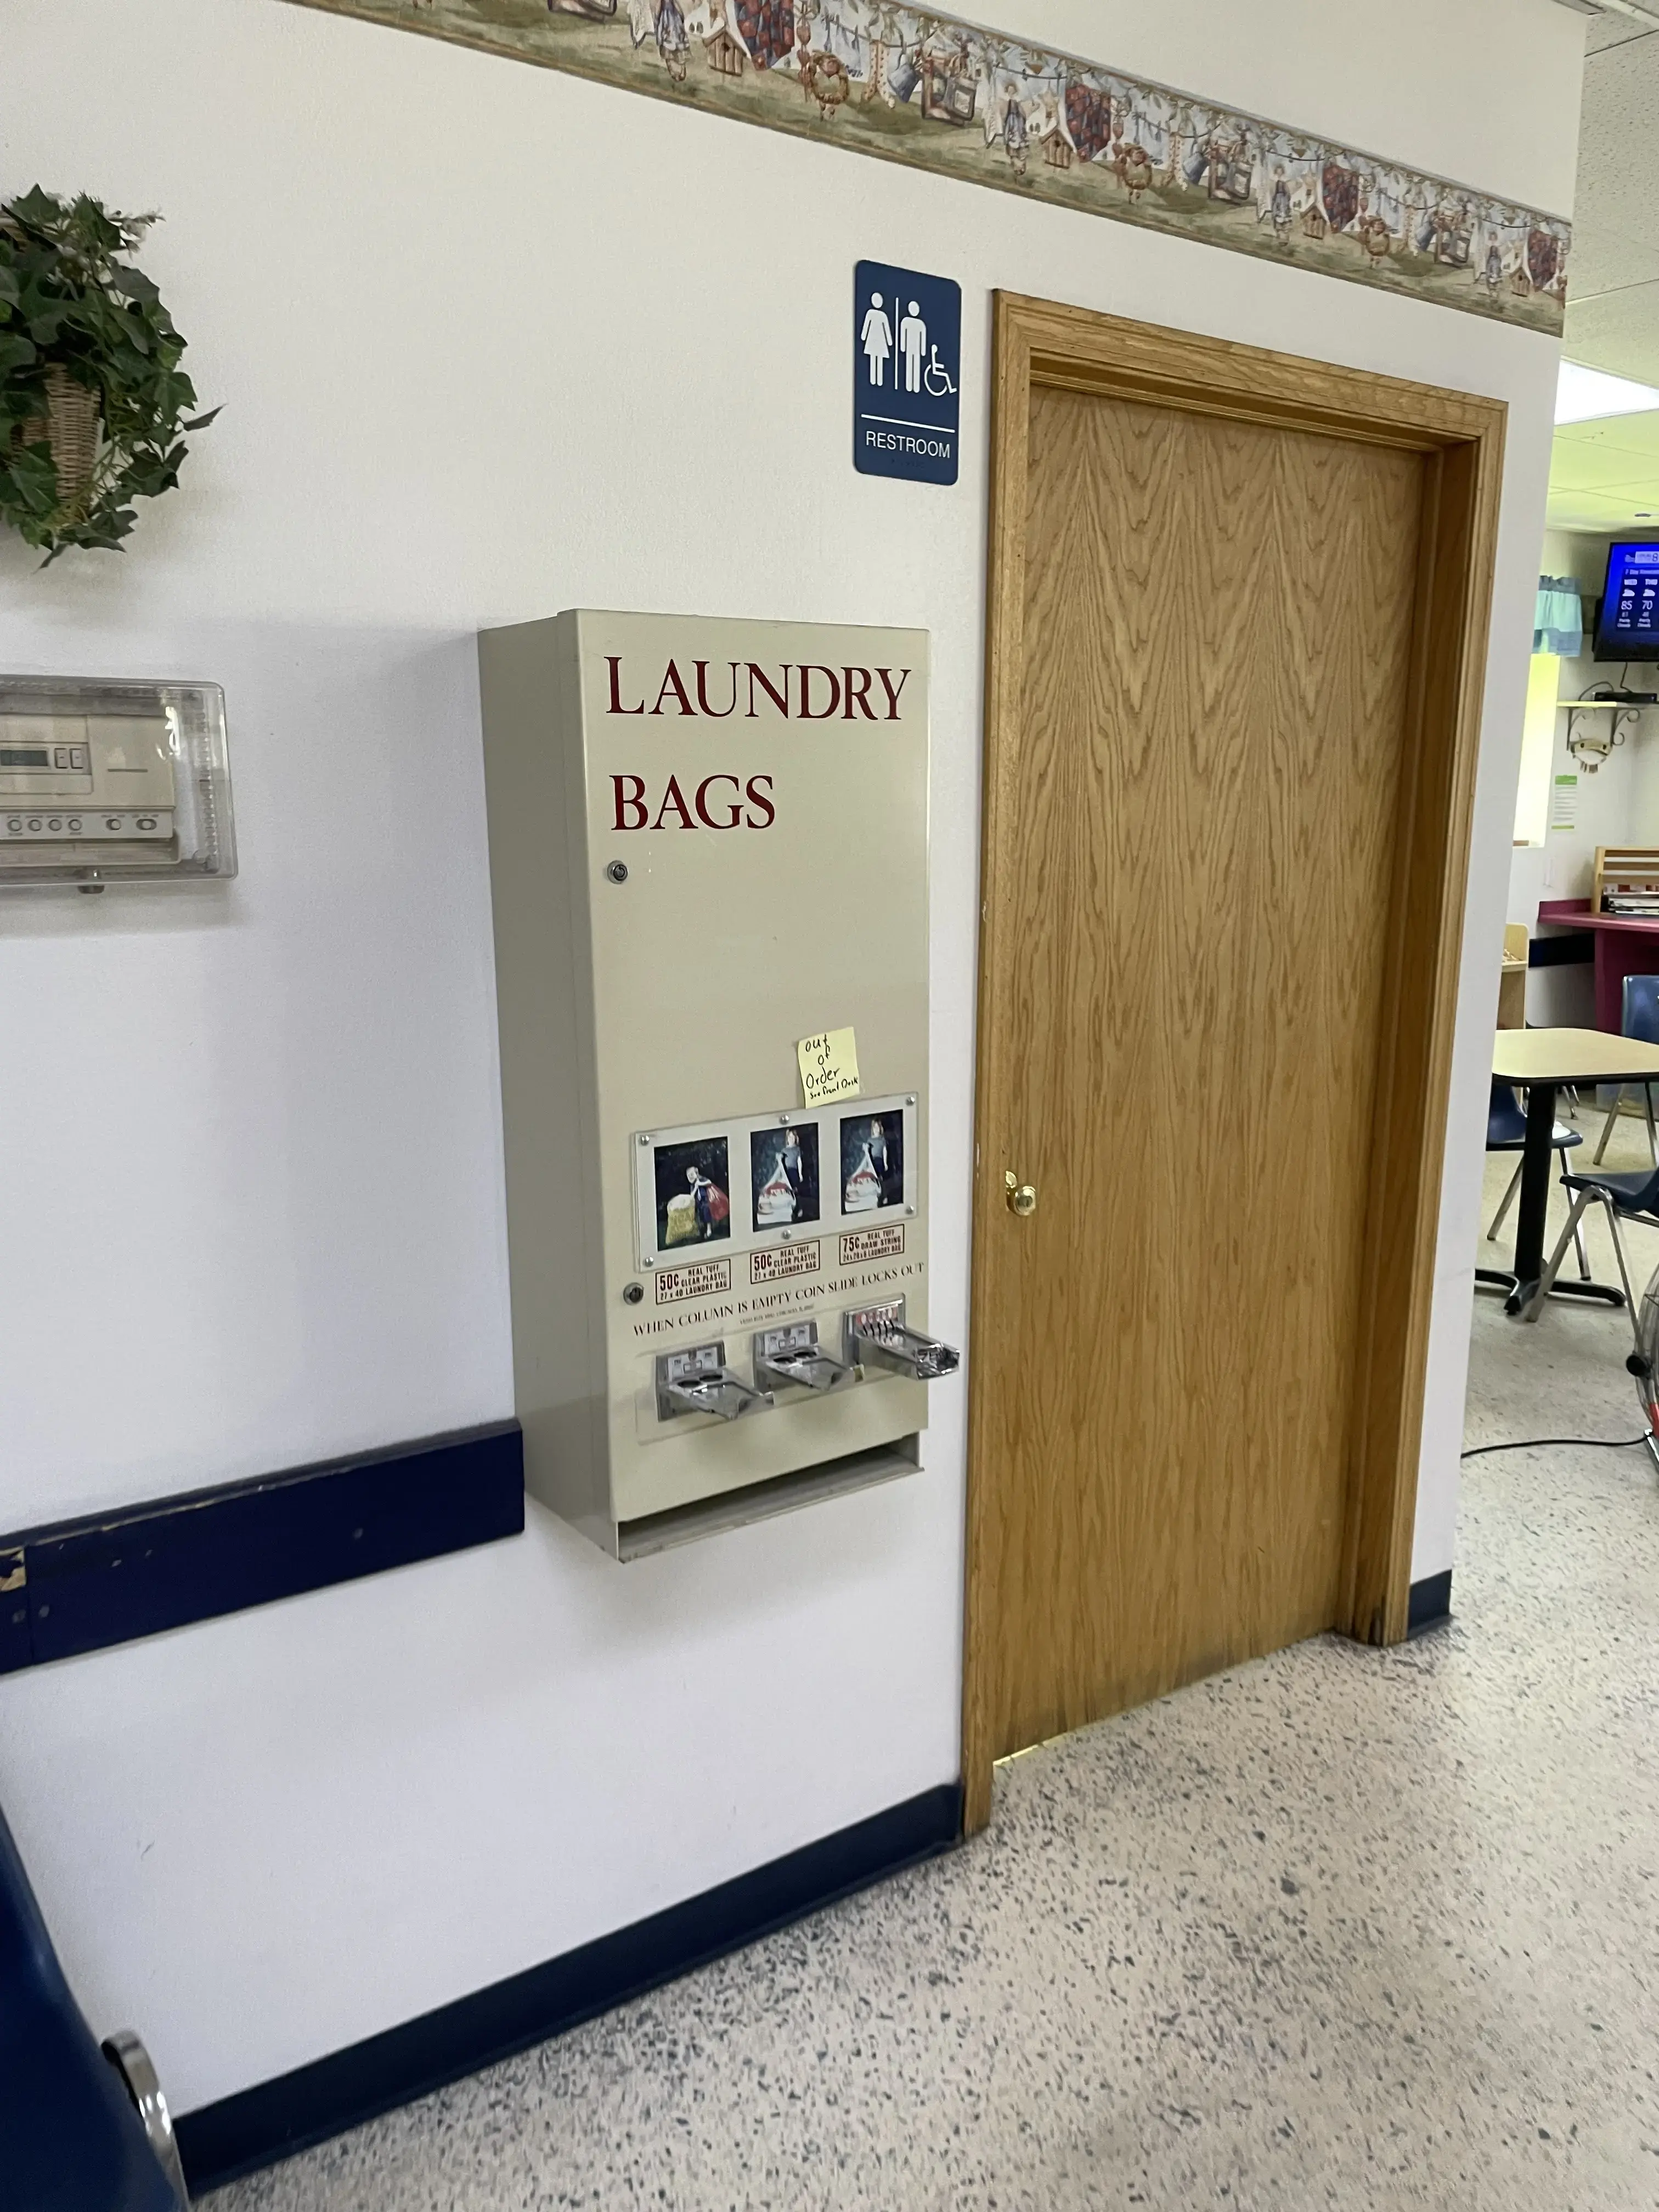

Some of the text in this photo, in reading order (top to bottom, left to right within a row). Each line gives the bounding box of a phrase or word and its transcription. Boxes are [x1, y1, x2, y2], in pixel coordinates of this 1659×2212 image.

[866, 430, 950, 459] RESTROOM
[603, 656, 912, 720] LAUNDRY
[609, 774, 775, 831] BAGS
[817, 1045, 831, 1065] of
[806, 1066, 840, 1089] Order
[861, 1240, 878, 1250] DRAW
[880, 1235, 901, 1246] STRING
[867, 1232, 881, 1240] REAL
[780, 1245, 809, 1257] REAL TUFF
[868, 1246, 890, 1257] LAUNDRY
[891, 1244, 901, 1252] BAG
[774, 1257, 791, 1268] CLEAR
[793, 1251, 816, 1263] PLASTIC
[778, 1263, 803, 1276] LAUNDRY
[805, 1260, 816, 1269] BAG
[688, 1263, 719, 1277] REAL TUFF
[681, 1277, 700, 1288] CLEAR
[702, 1271, 727, 1283] PLASTIC
[675, 1289, 683, 1297] 40
[686, 1283, 713, 1295] LAUNDRY
[715, 1280, 727, 1289] BAG
[633, 1317, 674, 1336] WHEN
[679, 1304, 733, 1327] COLUMN
[738, 1300, 748, 1314] IS
[752, 1288, 792, 1311] EMPTY
[795, 1283, 825, 1301] COIN
[828, 1276, 859, 1294] SLIDE
[861, 1267, 898, 1286] LOCKS
[901, 1261, 925, 1278] OUT
